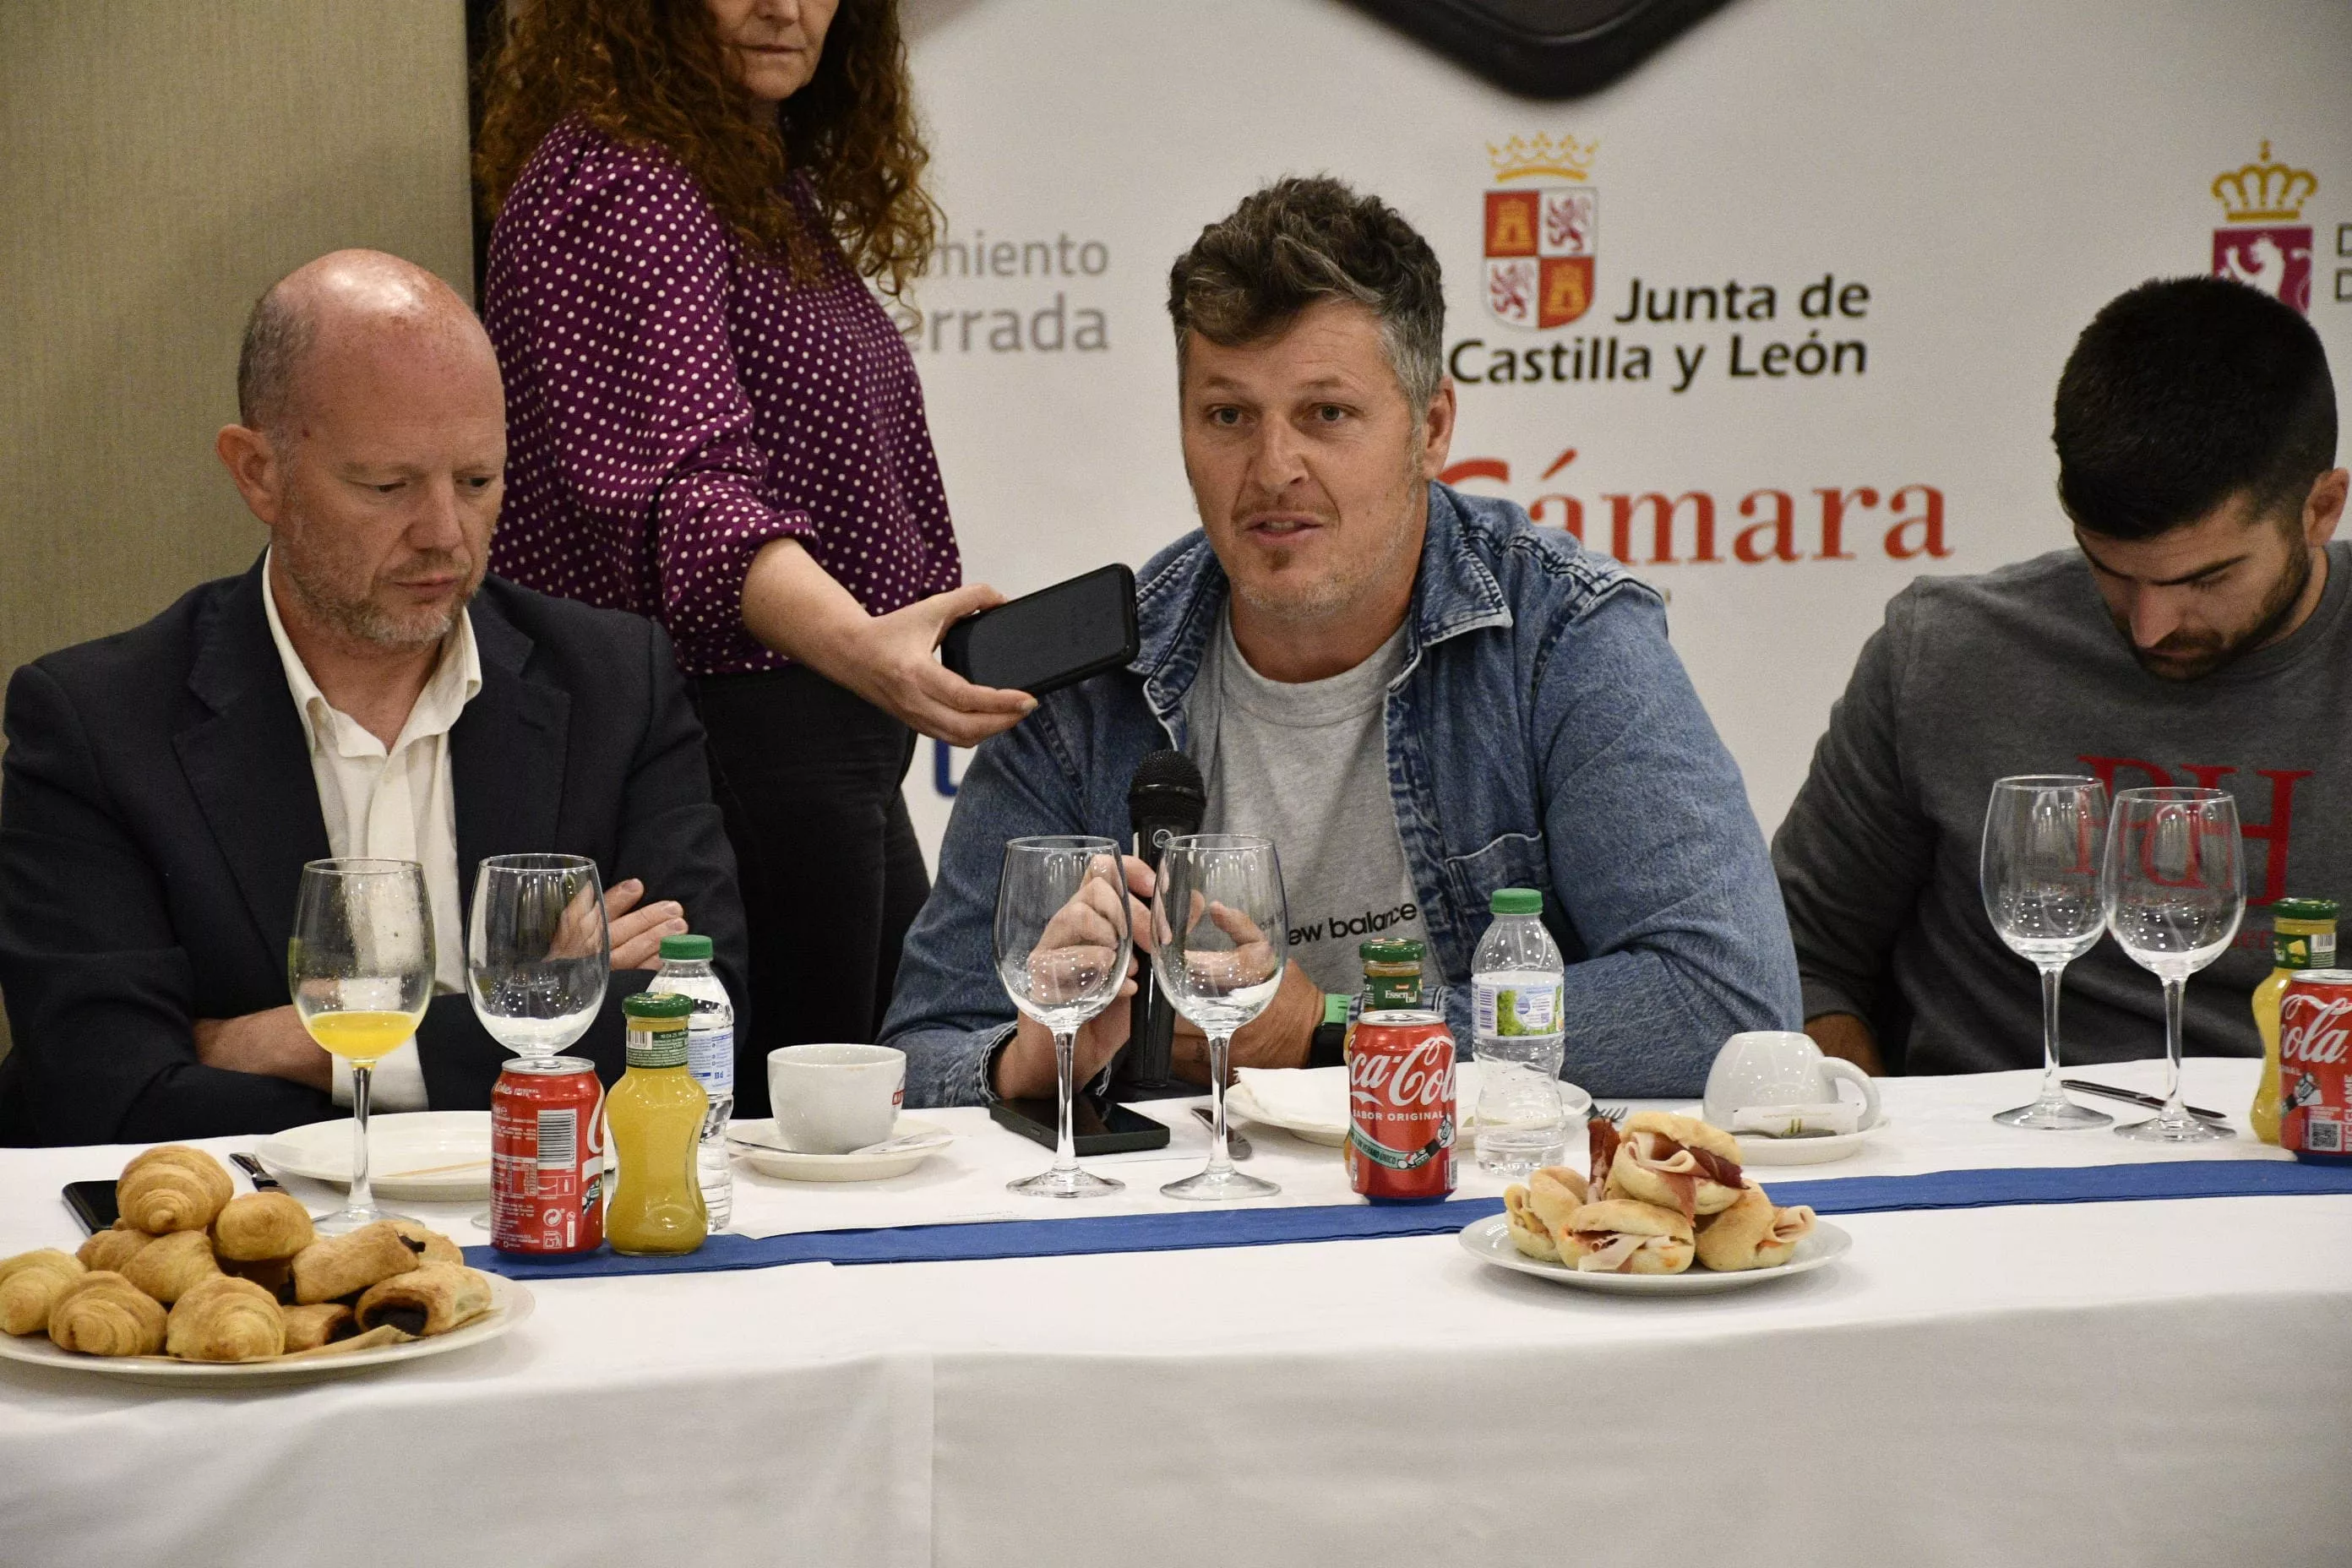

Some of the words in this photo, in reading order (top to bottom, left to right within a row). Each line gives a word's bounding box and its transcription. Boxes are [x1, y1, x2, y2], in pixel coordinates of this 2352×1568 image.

[1614, 278, 1777, 324] Junta
[1799, 273, 1870, 319] de
[1448, 336, 1652, 384] Castilla
[1670, 343, 1706, 394] y
[1729, 329, 1868, 378] León
[1437, 448, 1954, 566] ámara
[1328, 902, 1418, 939] balance
[1386, 1110, 1445, 1122] ORIGINAL
